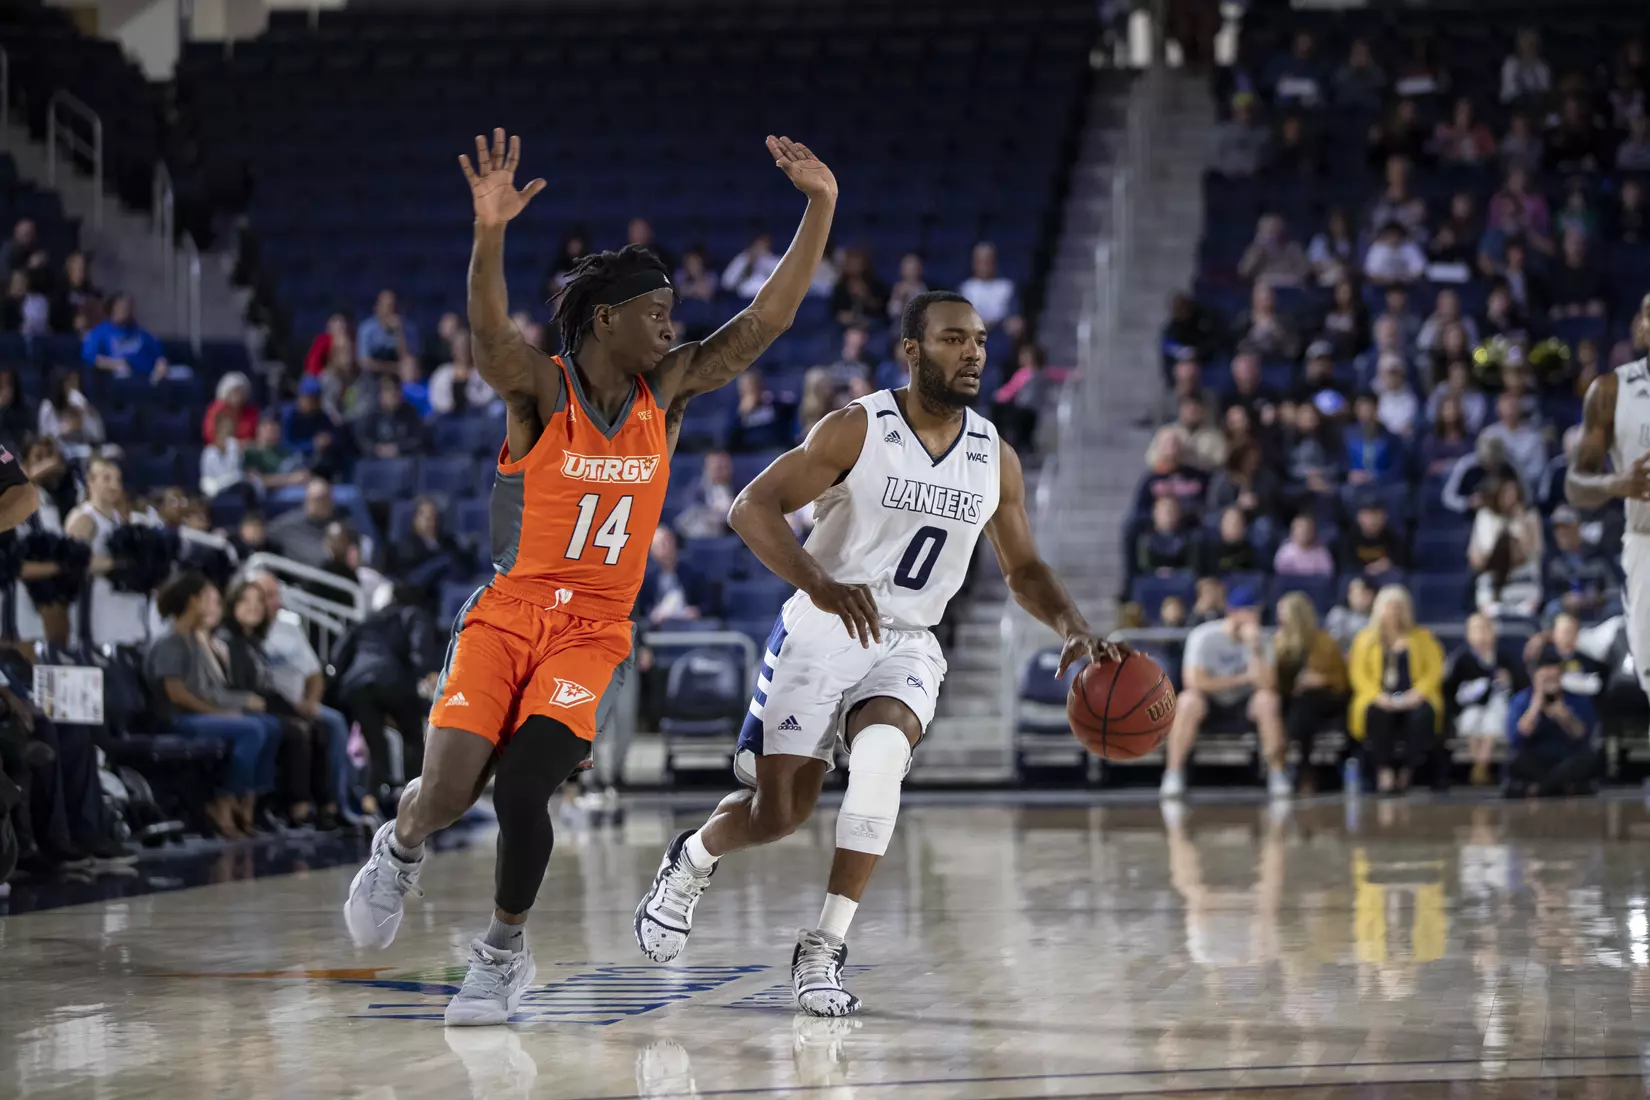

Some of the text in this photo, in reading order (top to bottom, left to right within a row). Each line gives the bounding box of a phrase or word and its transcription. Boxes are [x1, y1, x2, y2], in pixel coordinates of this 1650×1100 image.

[562, 452, 659, 483] UTRGV
[966, 451, 988, 464] WAC
[882, 476, 983, 525] LANCERS
[564, 493, 633, 566] 14
[893, 525, 948, 591] 0
